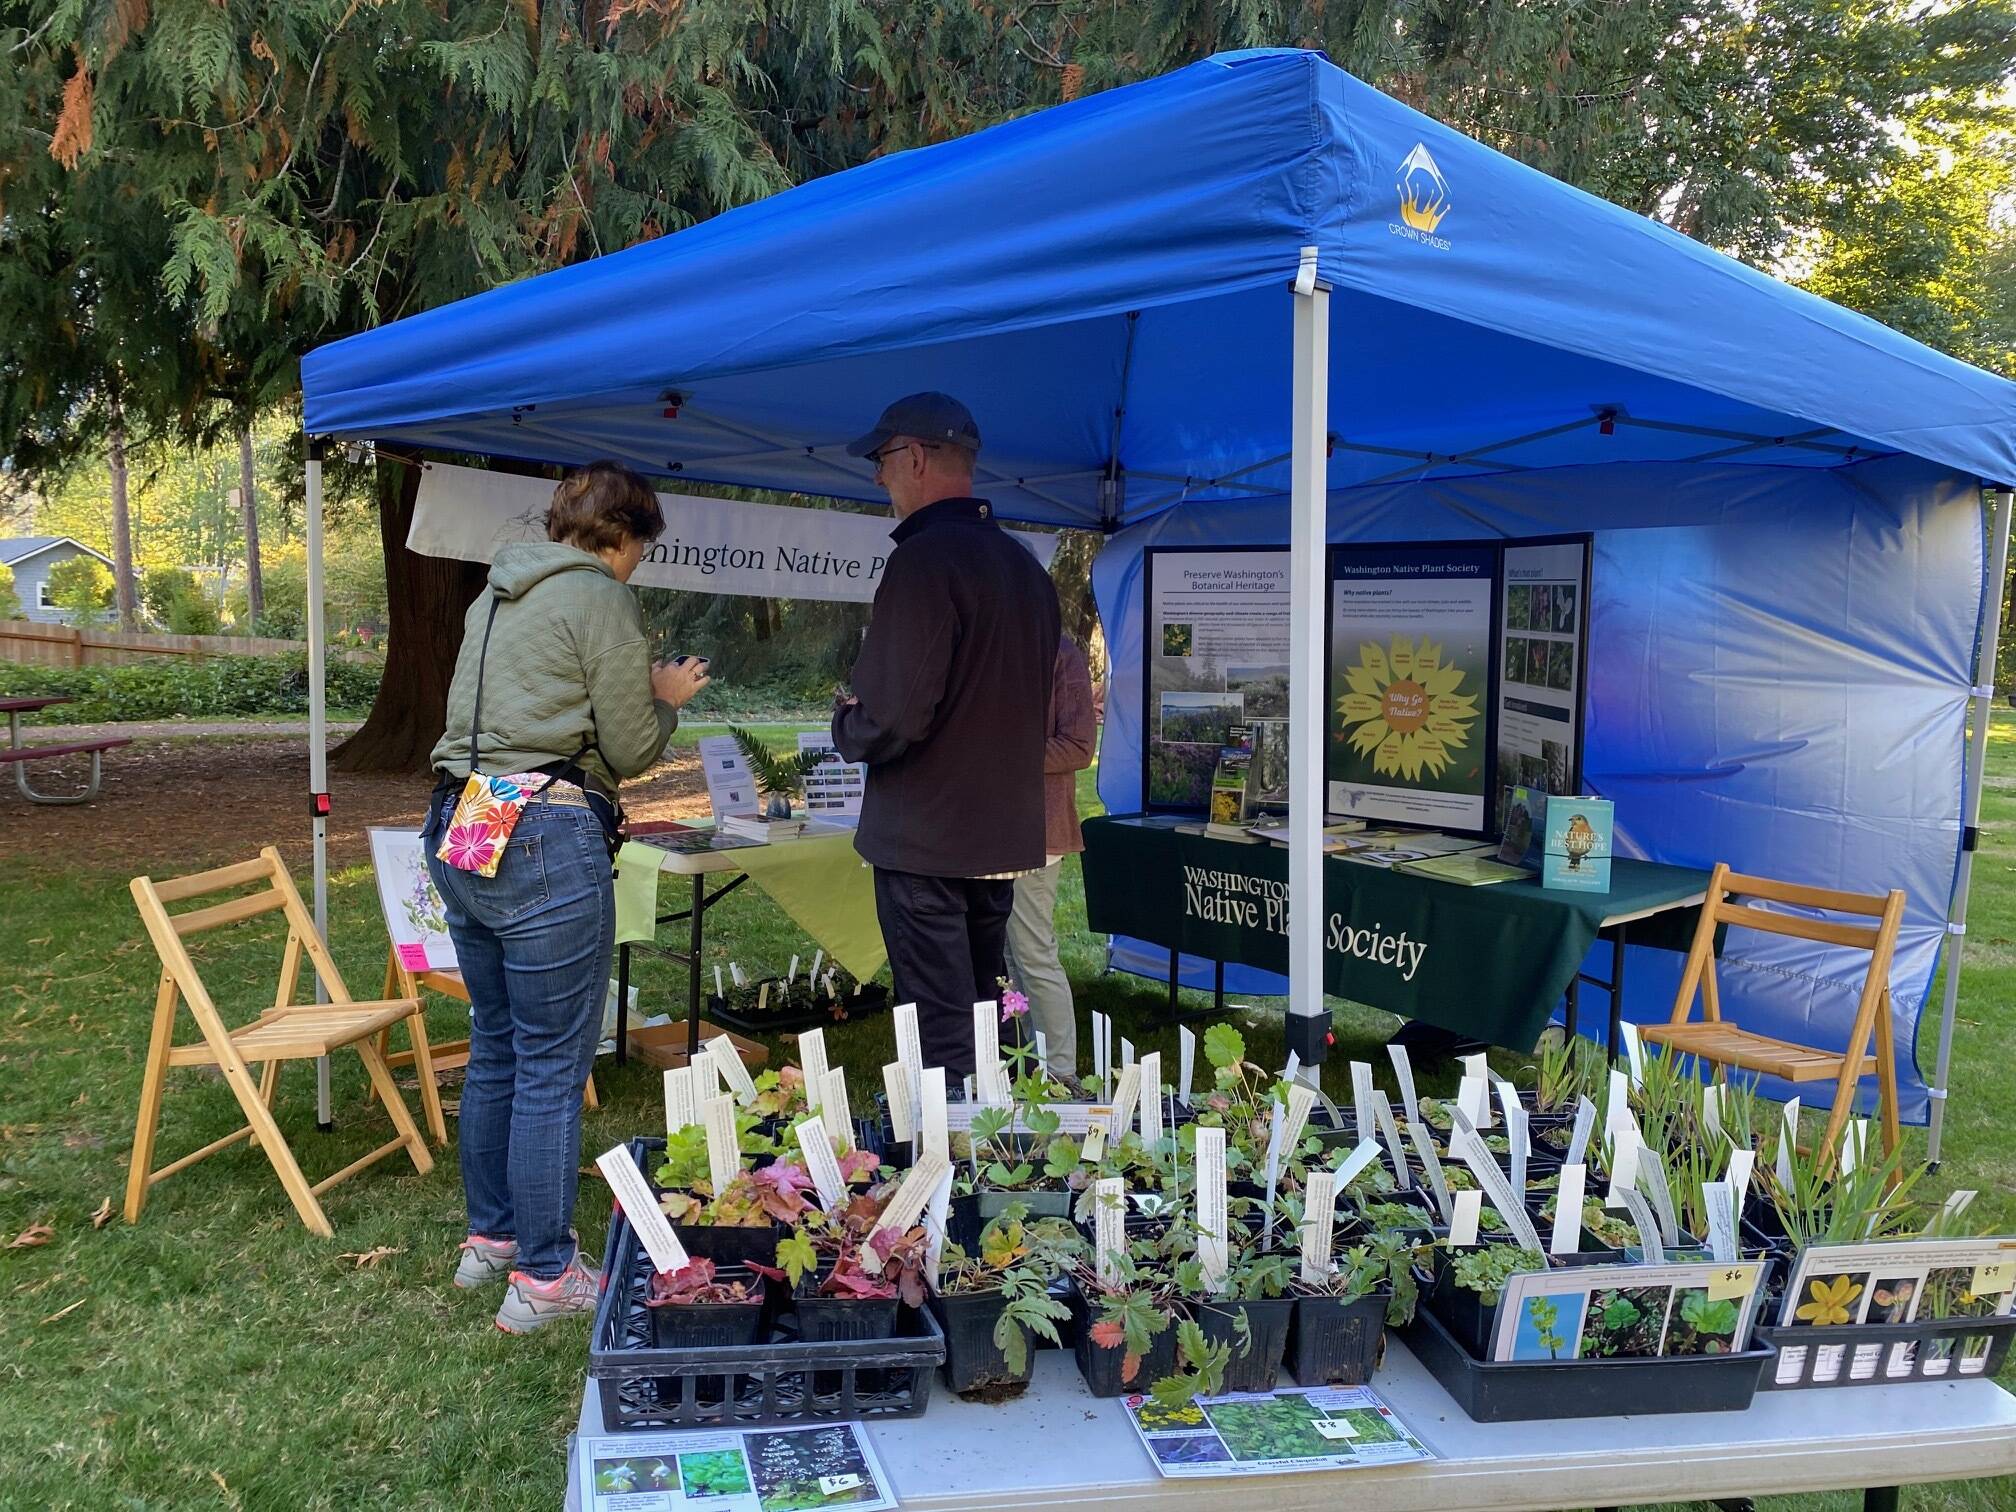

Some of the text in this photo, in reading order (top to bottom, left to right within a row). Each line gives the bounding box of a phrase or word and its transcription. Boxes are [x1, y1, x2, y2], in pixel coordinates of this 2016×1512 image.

[1388, 223, 1419, 242] CROWN
[640, 538, 765, 576] hington
[774, 546, 861, 579] Native
[1184, 569, 1284, 581] Preserve Washington's
[1344, 563, 1480, 575] Washington Native Plant Society
[1192, 581, 1276, 592] Botanical Heritage
[1389, 693, 1423, 706] Why Go
[1389, 707, 1423, 717] Native?
[1551, 839, 1607, 851] BEST HOPE
[1184, 882, 1259, 929] Native
[1326, 912, 1428, 982] Society
[1088, 1124, 1099, 1138] $9
[1725, 1270, 1742, 1281] $6
[1984, 1266, 2000, 1276] $9
[828, 1477, 849, 1487] $6
